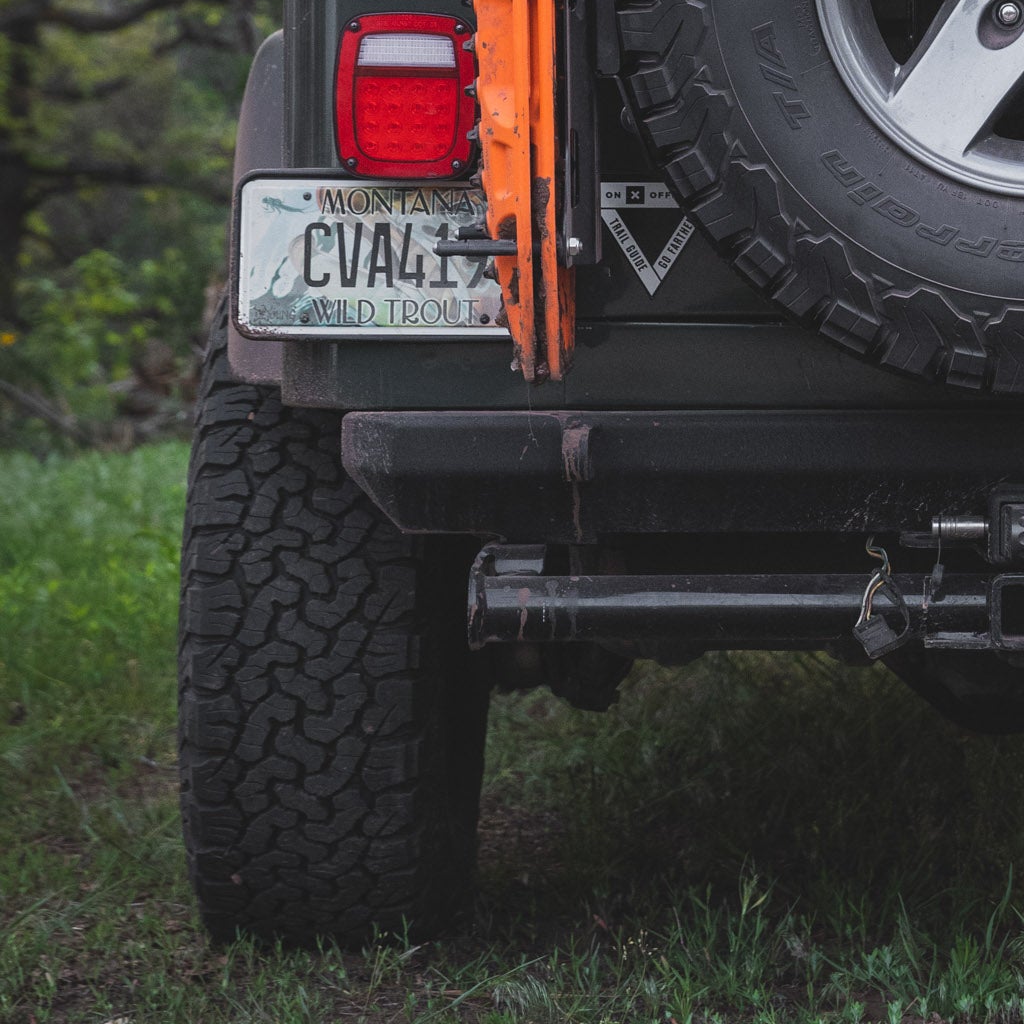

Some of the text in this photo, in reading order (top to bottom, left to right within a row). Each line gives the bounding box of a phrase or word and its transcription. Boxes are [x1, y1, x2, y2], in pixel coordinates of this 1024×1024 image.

[750, 19, 813, 131] T/A
[321, 188, 475, 216] MONTANA
[605, 191, 621, 199] ON
[609, 218, 648, 272] TRAIL GUIDE
[658, 220, 693, 269] GO FARTHE
[312, 299, 375, 325] WILD
[384, 299, 479, 325] TROUT
